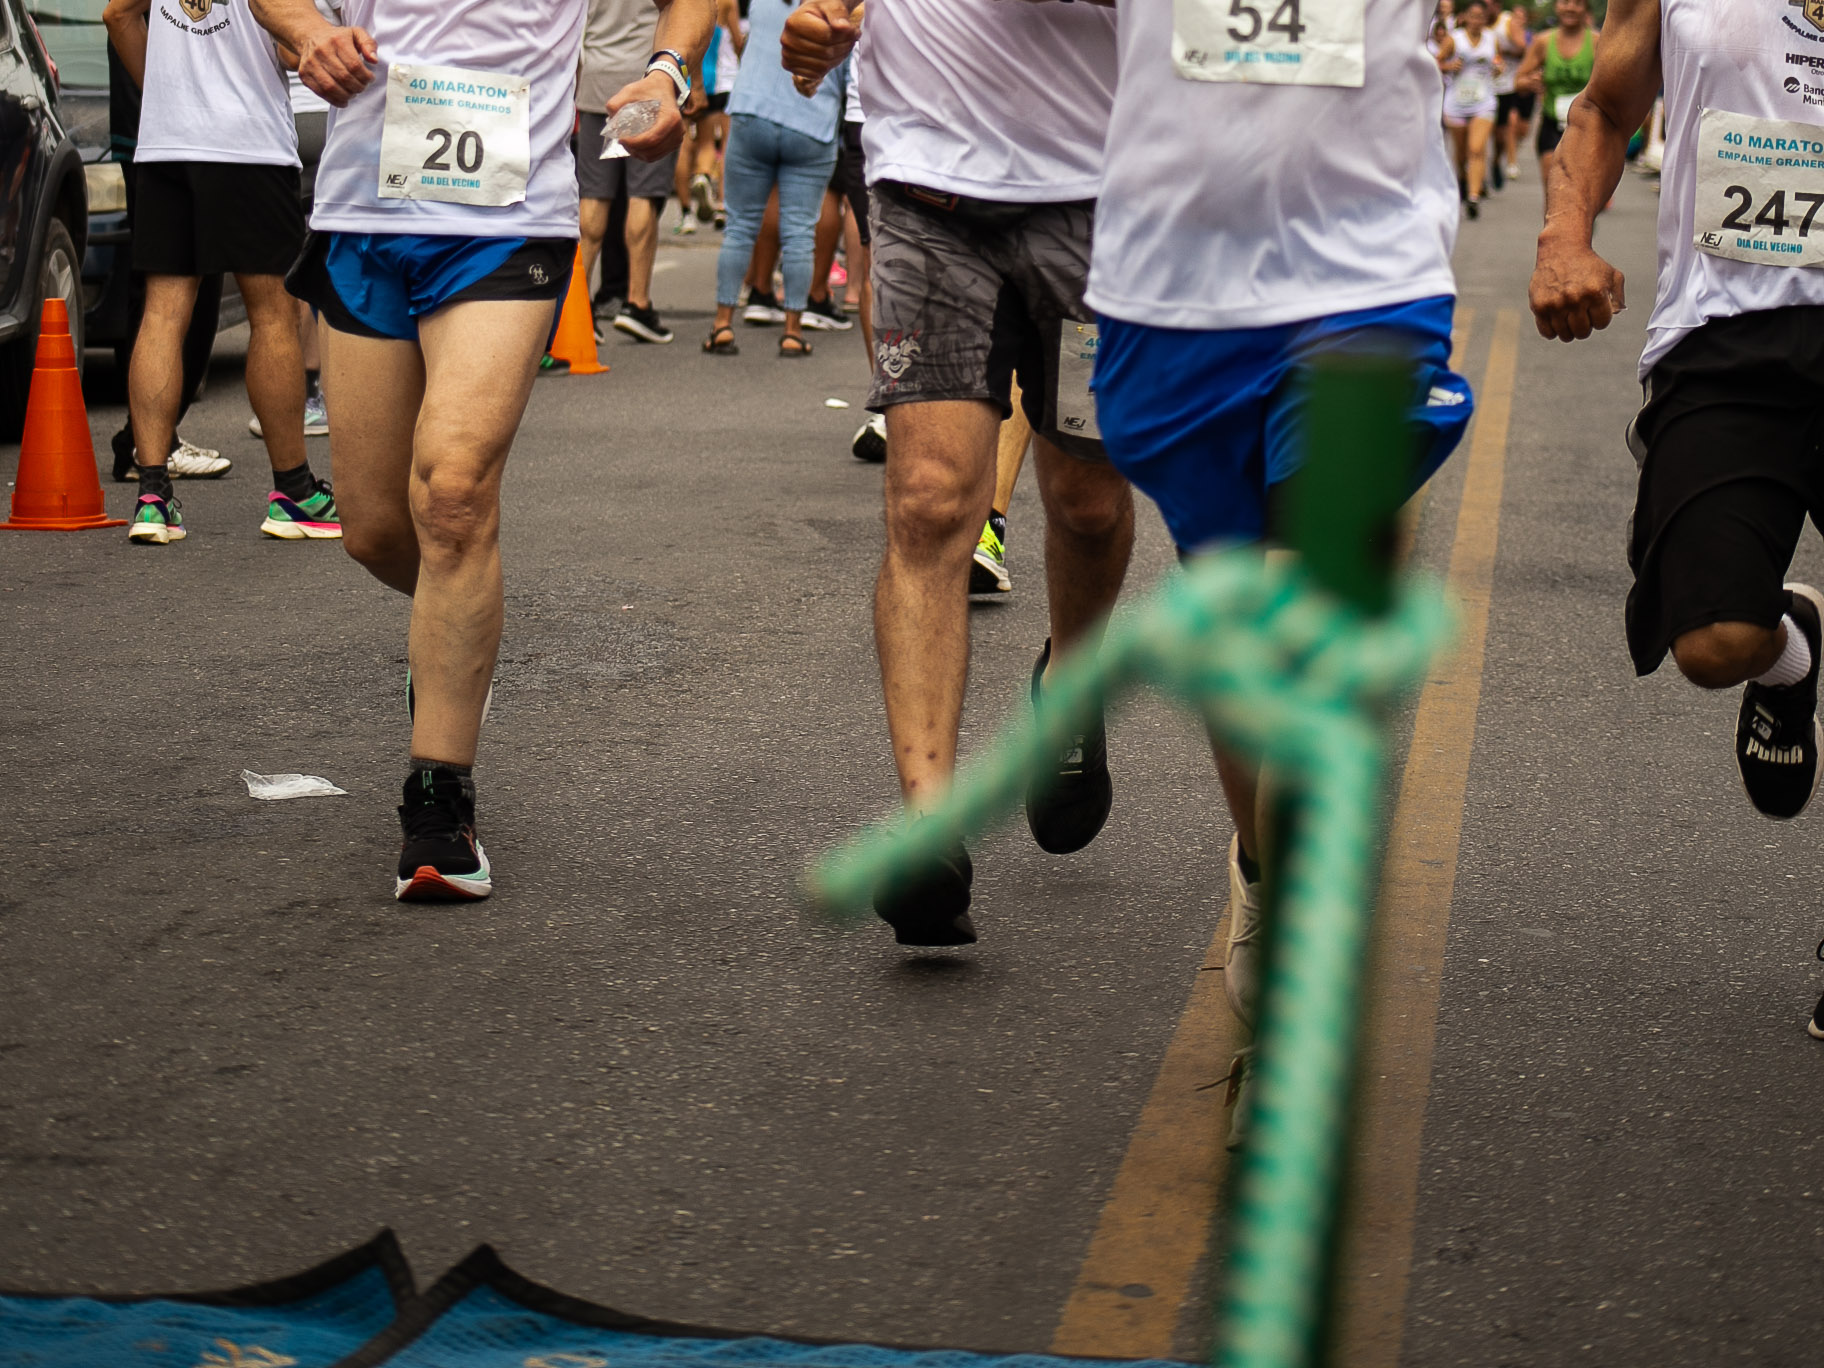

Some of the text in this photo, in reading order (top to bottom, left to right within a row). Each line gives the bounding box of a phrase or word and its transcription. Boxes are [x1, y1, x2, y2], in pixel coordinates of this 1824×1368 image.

[1781, 15, 1818, 42] EMPALME
[409, 78, 508, 99] 40 MARATON
[404, 95, 512, 114] EMPALME GRANEROS
[422, 128, 484, 174] 20
[1723, 132, 1824, 154] 40 MARATO
[1717, 149, 1773, 166] EMPALME
[386, 173, 408, 186] NEJ
[421, 175, 480, 188] DIA DEL VECINO
[1721, 185, 1824, 238] 247
[1700, 232, 1723, 247] NEJ
[1736, 238, 1803, 254] DIA DEL VECINO
[1064, 417, 1087, 430] NEJ
